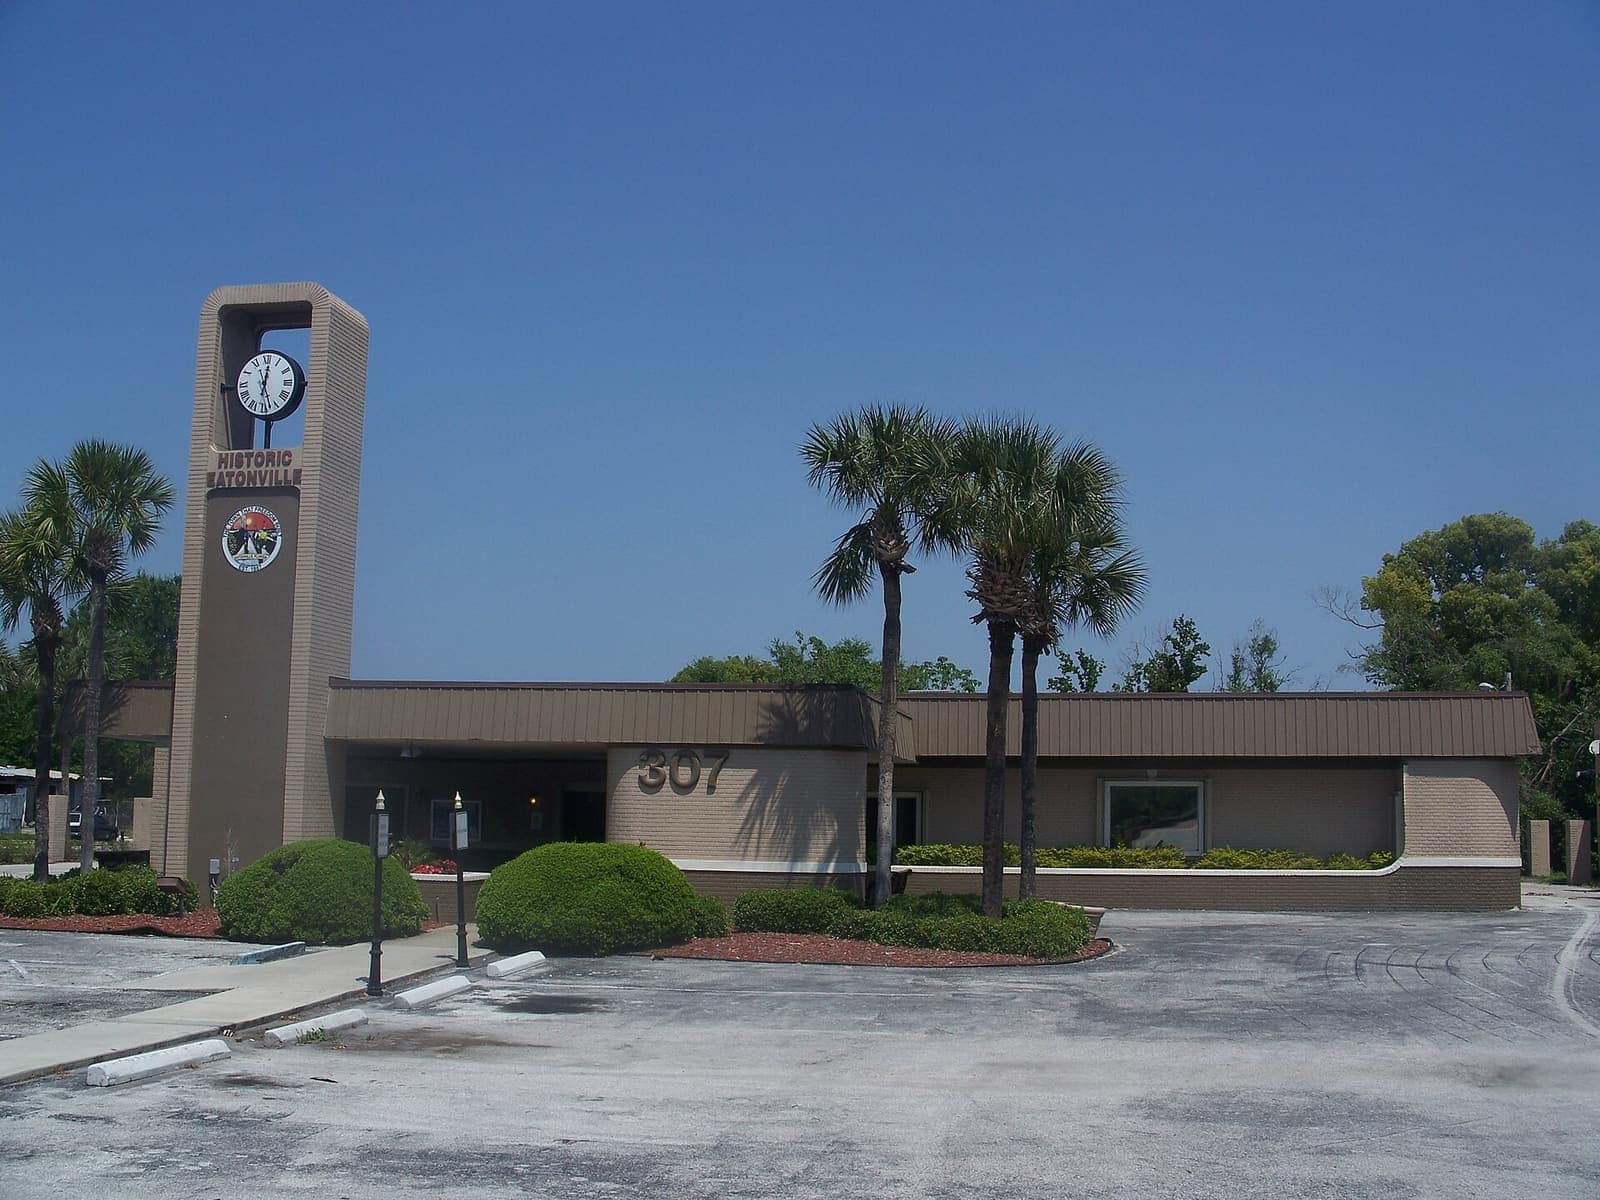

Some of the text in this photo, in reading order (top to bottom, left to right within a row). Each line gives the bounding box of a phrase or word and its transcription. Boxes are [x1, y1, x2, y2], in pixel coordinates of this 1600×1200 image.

[217, 450, 293, 470] HISTORIC
[207, 468, 303, 488] EATONVILLE
[638, 749, 730, 794] 307
